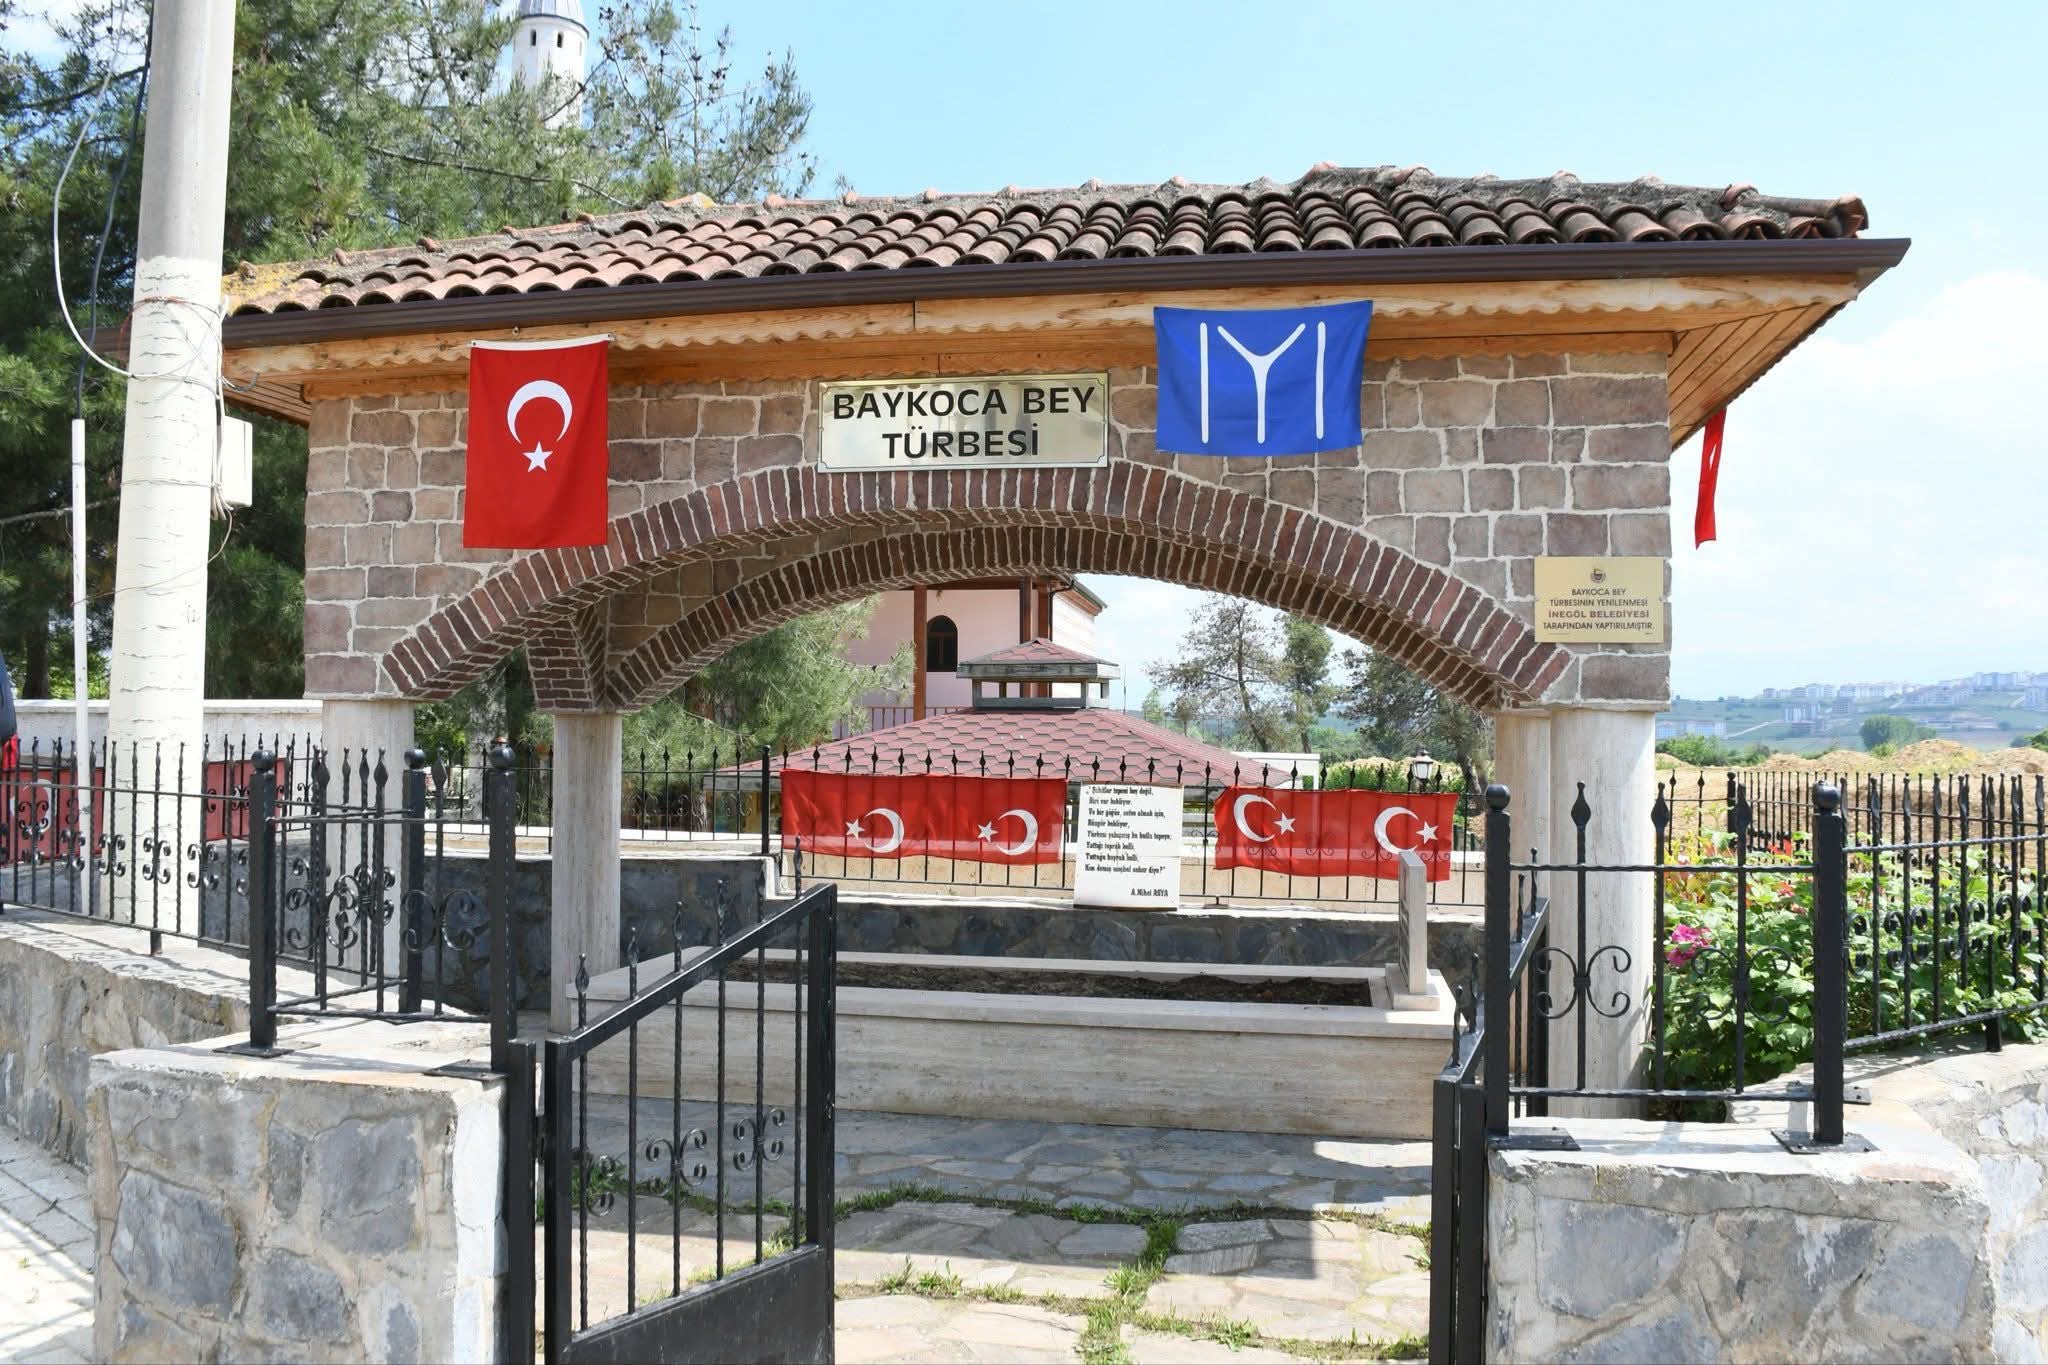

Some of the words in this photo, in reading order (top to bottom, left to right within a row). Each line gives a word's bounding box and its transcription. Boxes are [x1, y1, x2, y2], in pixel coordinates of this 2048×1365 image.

[833, 388, 1008, 420] BAYKOCA
[1022, 386, 1096, 415] BEY
[881, 422, 1039, 459] TÜRBESİ
[1571, 588, 1610, 596] BAYKOCA
[1612, 588, 1627, 596] BEY
[1548, 608, 1587, 618] İNEGÖL
[1589, 608, 1650, 618] BELEDİYESİ
[1543, 621, 1593, 630] TARAFINDAN
